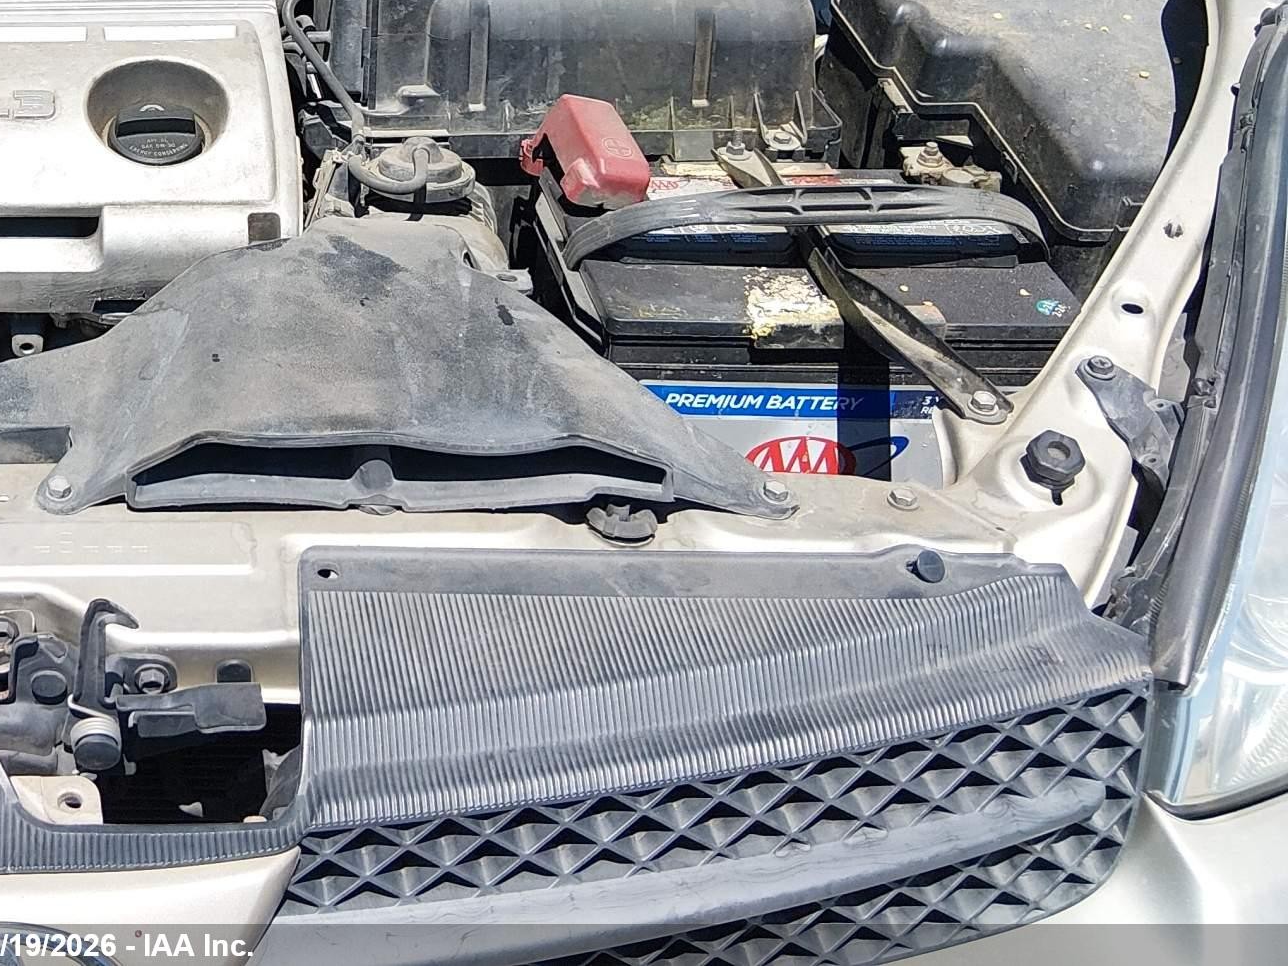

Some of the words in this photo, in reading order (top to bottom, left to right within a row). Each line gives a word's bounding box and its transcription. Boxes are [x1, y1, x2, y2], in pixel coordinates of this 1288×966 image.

[665, 392, 763, 409] PREMIUM
[765, 393, 864, 410] BATTERY
[921, 395, 932, 405] 3
